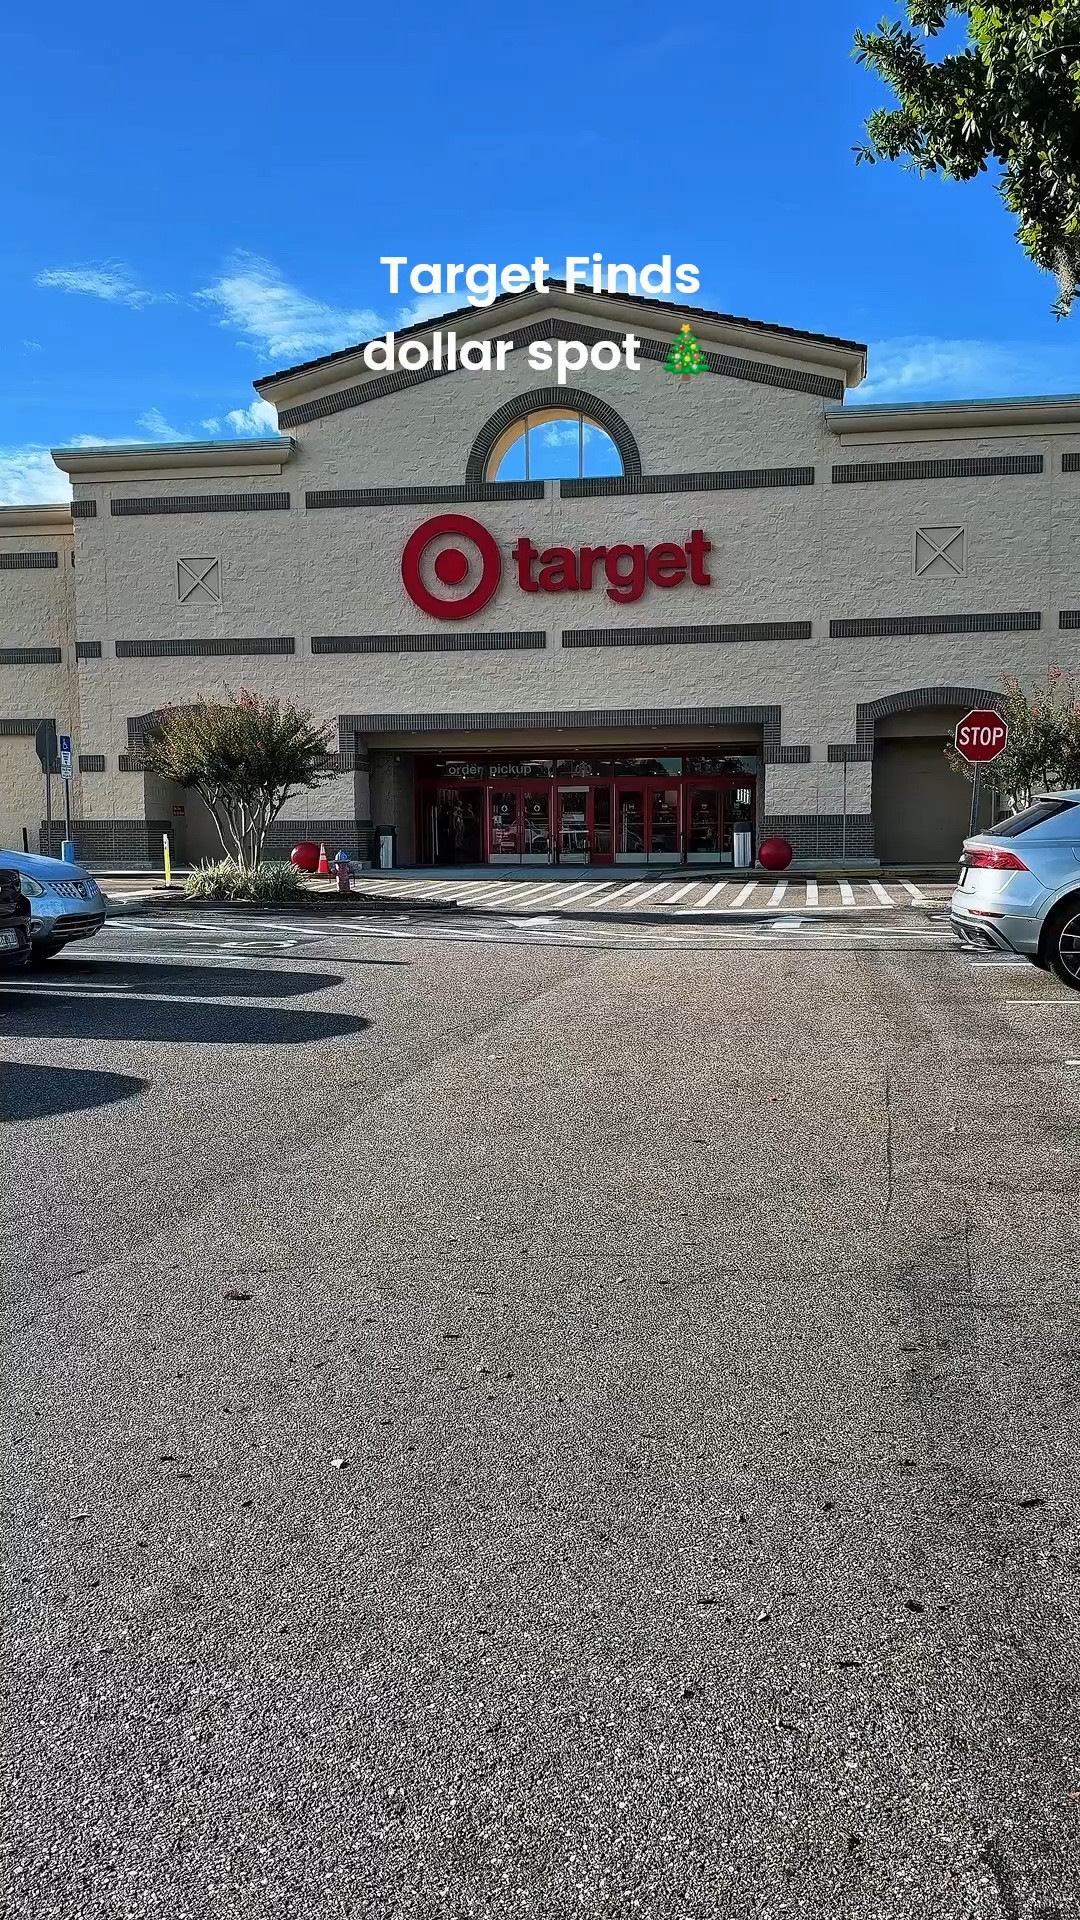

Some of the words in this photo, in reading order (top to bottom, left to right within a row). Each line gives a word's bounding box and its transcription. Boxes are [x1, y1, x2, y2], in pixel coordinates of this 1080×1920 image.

[512, 529, 712, 604] target
[959, 726, 1004, 746] STOP
[448, 763, 483, 775] order
[489, 763, 532, 776] pickup
